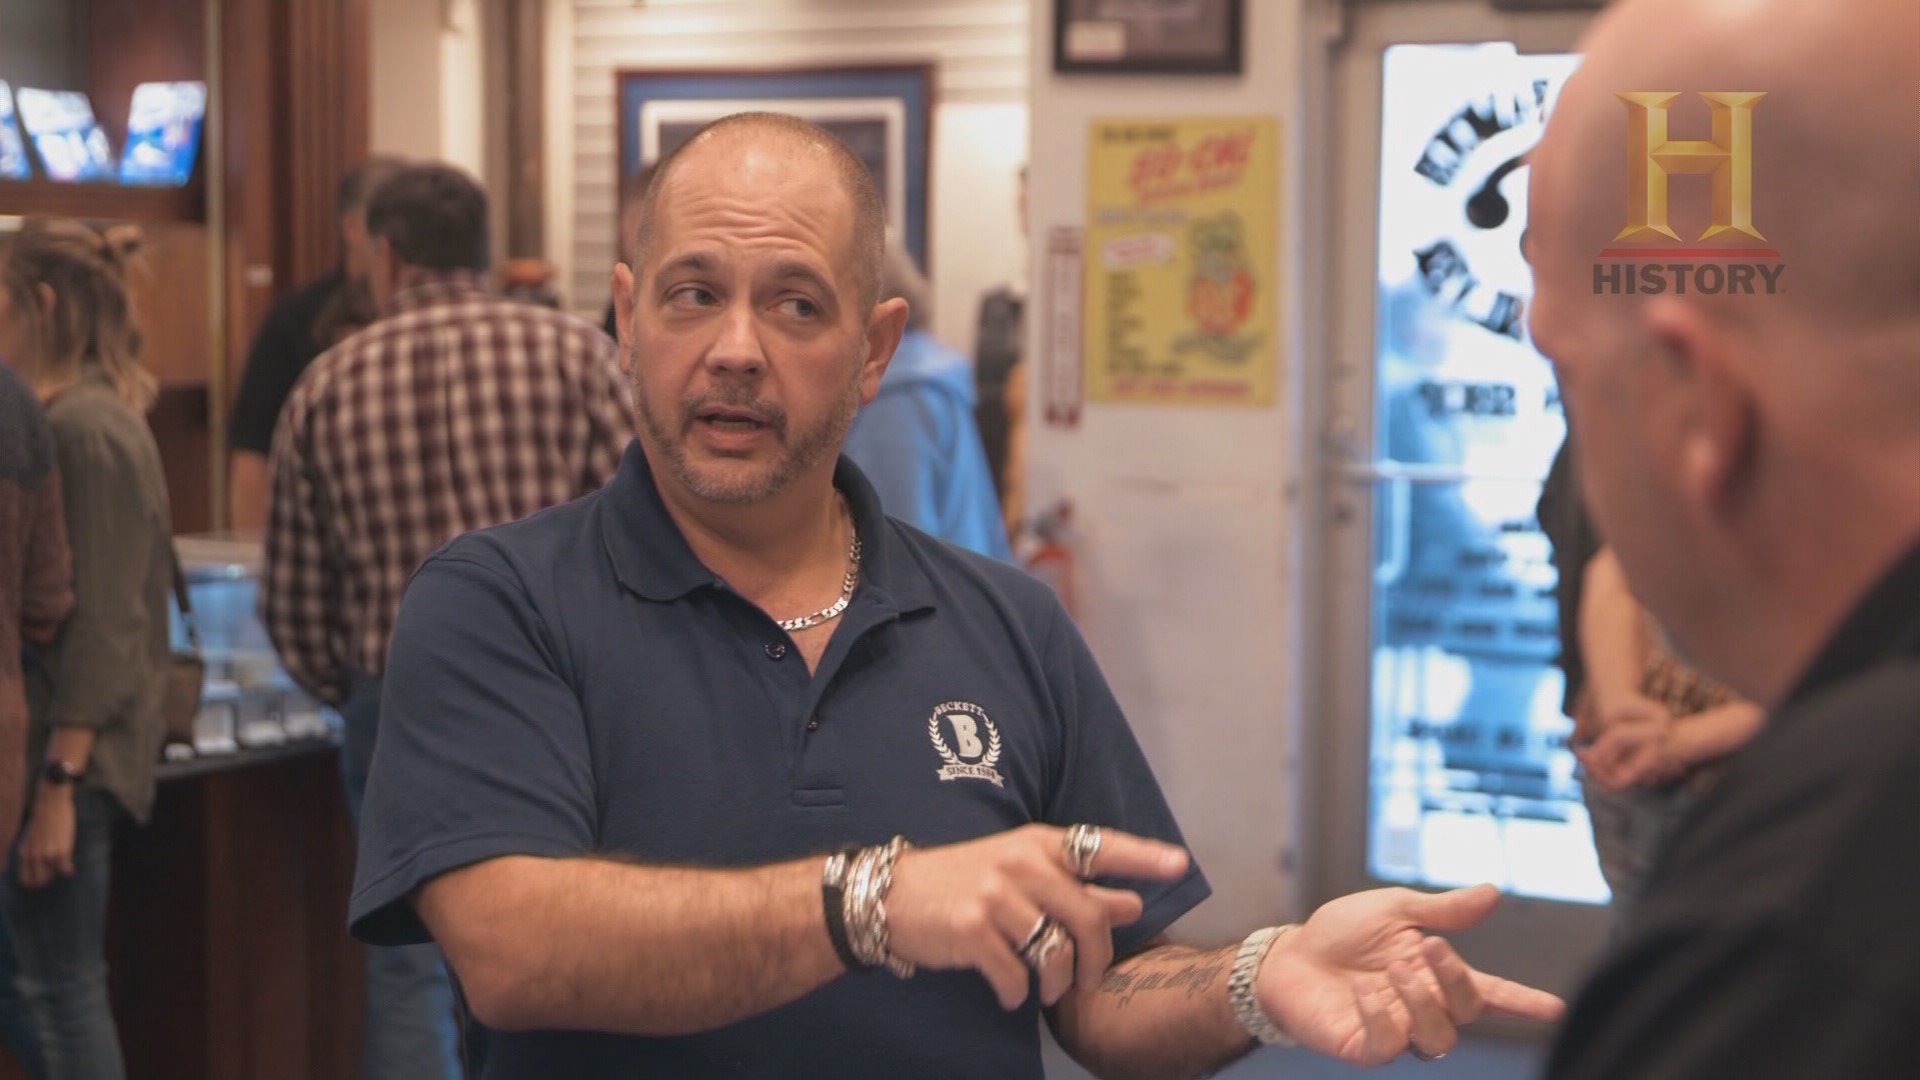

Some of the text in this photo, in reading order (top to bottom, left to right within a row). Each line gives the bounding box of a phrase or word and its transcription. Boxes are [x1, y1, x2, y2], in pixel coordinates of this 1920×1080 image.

[934, 701, 985, 716] BECKETT
[945, 714, 983, 758] B
[945, 766, 975, 776] SINCE
